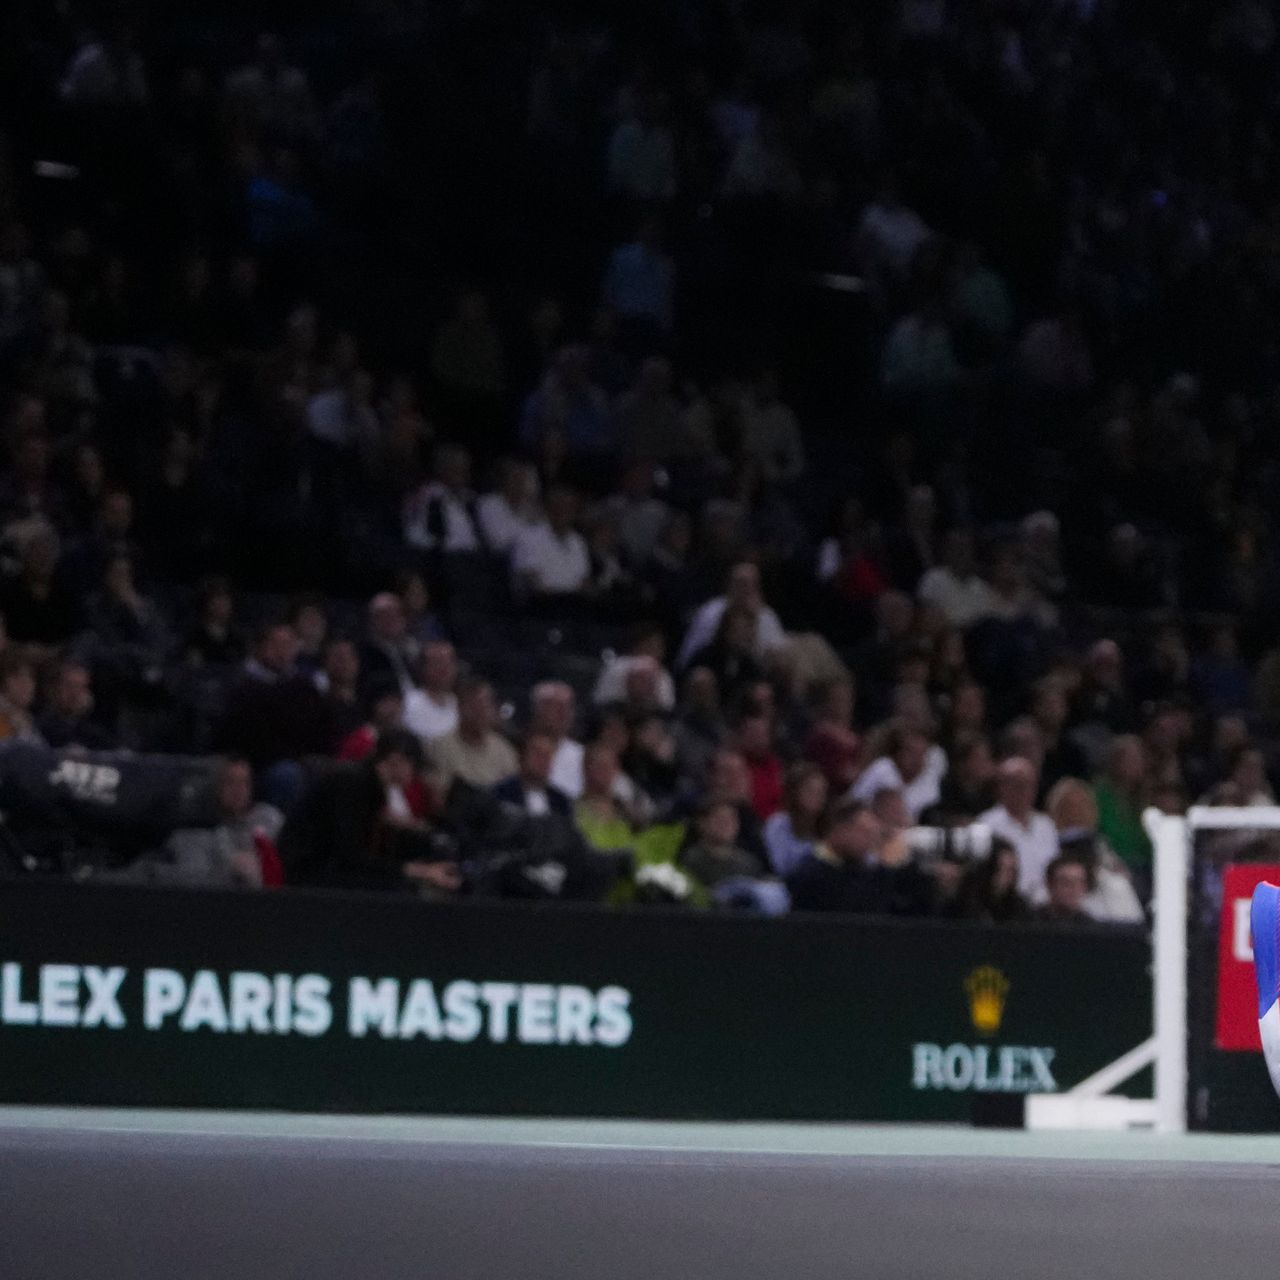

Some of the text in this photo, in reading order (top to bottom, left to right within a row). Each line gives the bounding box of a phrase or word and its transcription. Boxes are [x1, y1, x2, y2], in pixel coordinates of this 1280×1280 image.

[143, 967, 333, 1037] PARIS
[347, 976, 633, 1047] MASTERS
[912, 1041, 1057, 1092] ROLEX
